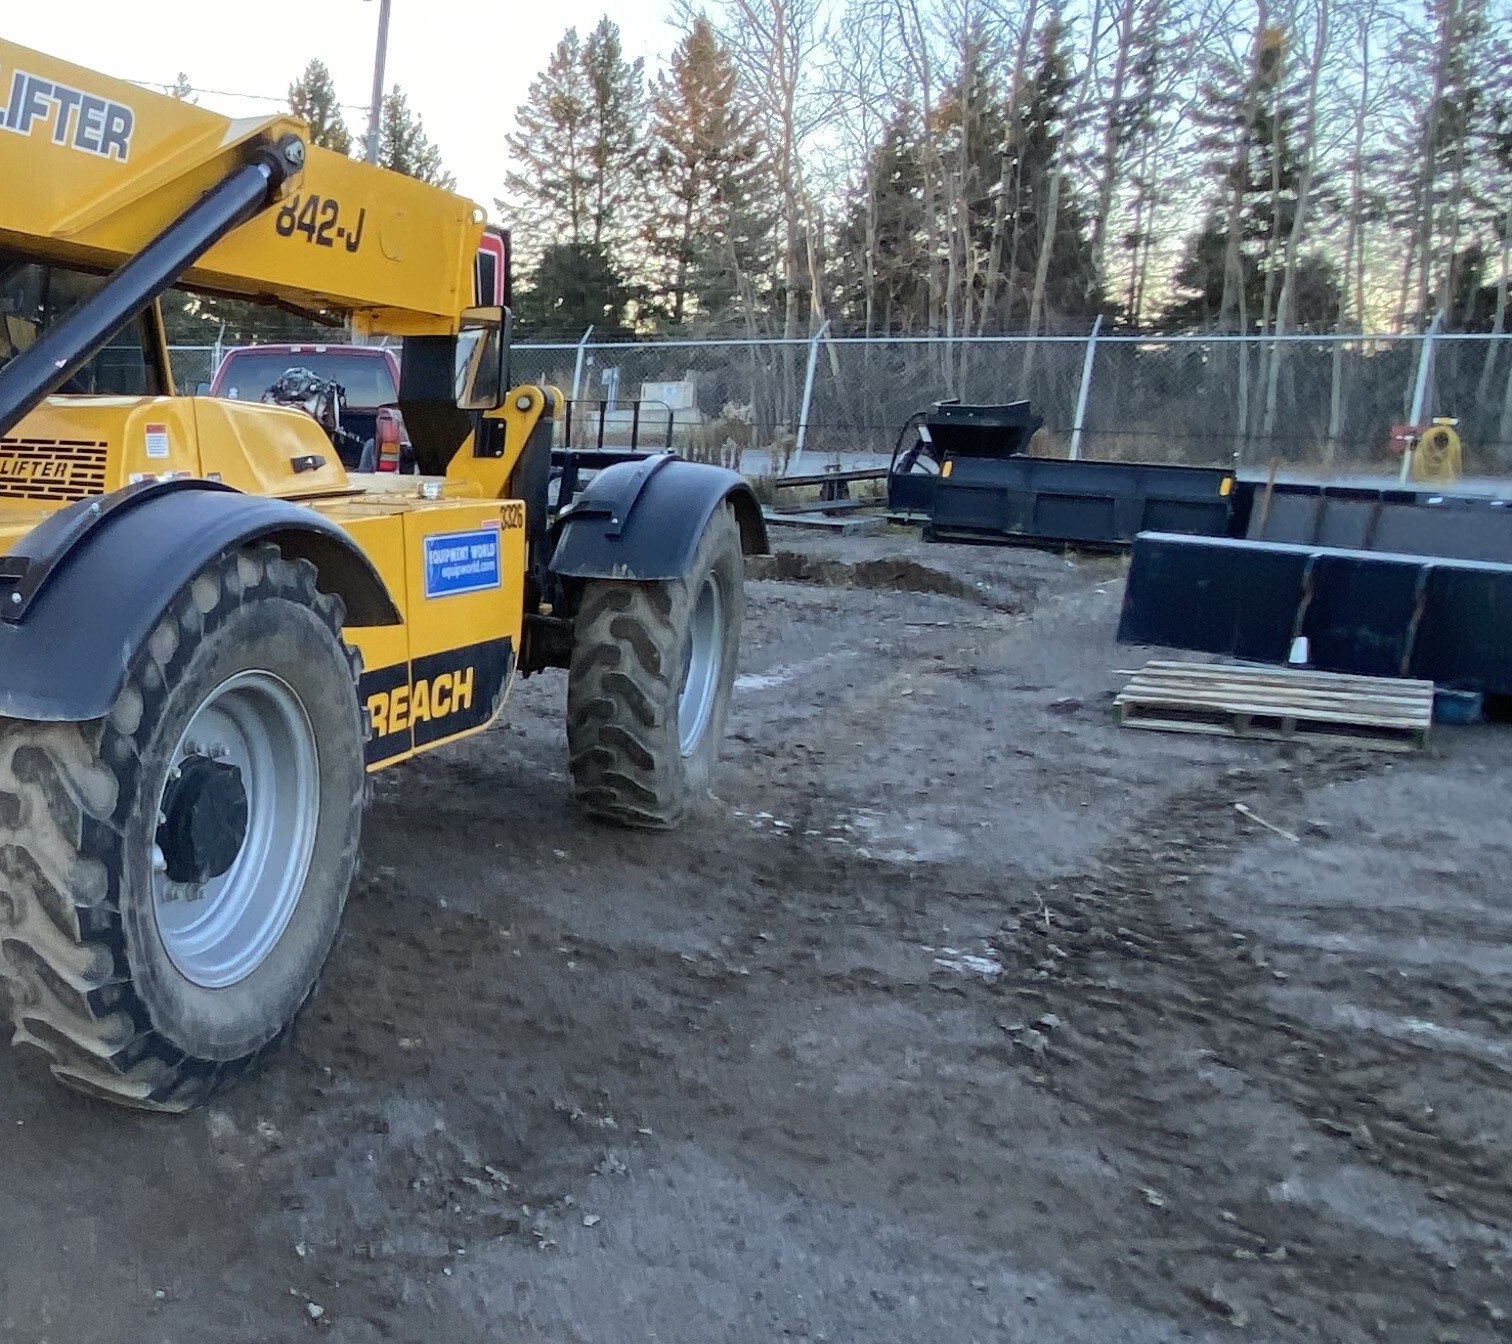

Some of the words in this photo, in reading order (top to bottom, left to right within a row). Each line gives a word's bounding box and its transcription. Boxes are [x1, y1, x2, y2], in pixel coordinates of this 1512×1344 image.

[276, 194, 366, 253] 842-J
[0, 459, 68, 477] LIFTER
[500, 503, 523, 531] 3326
[470, 543, 496, 559] WORLD
[367, 666, 474, 738] REACH
